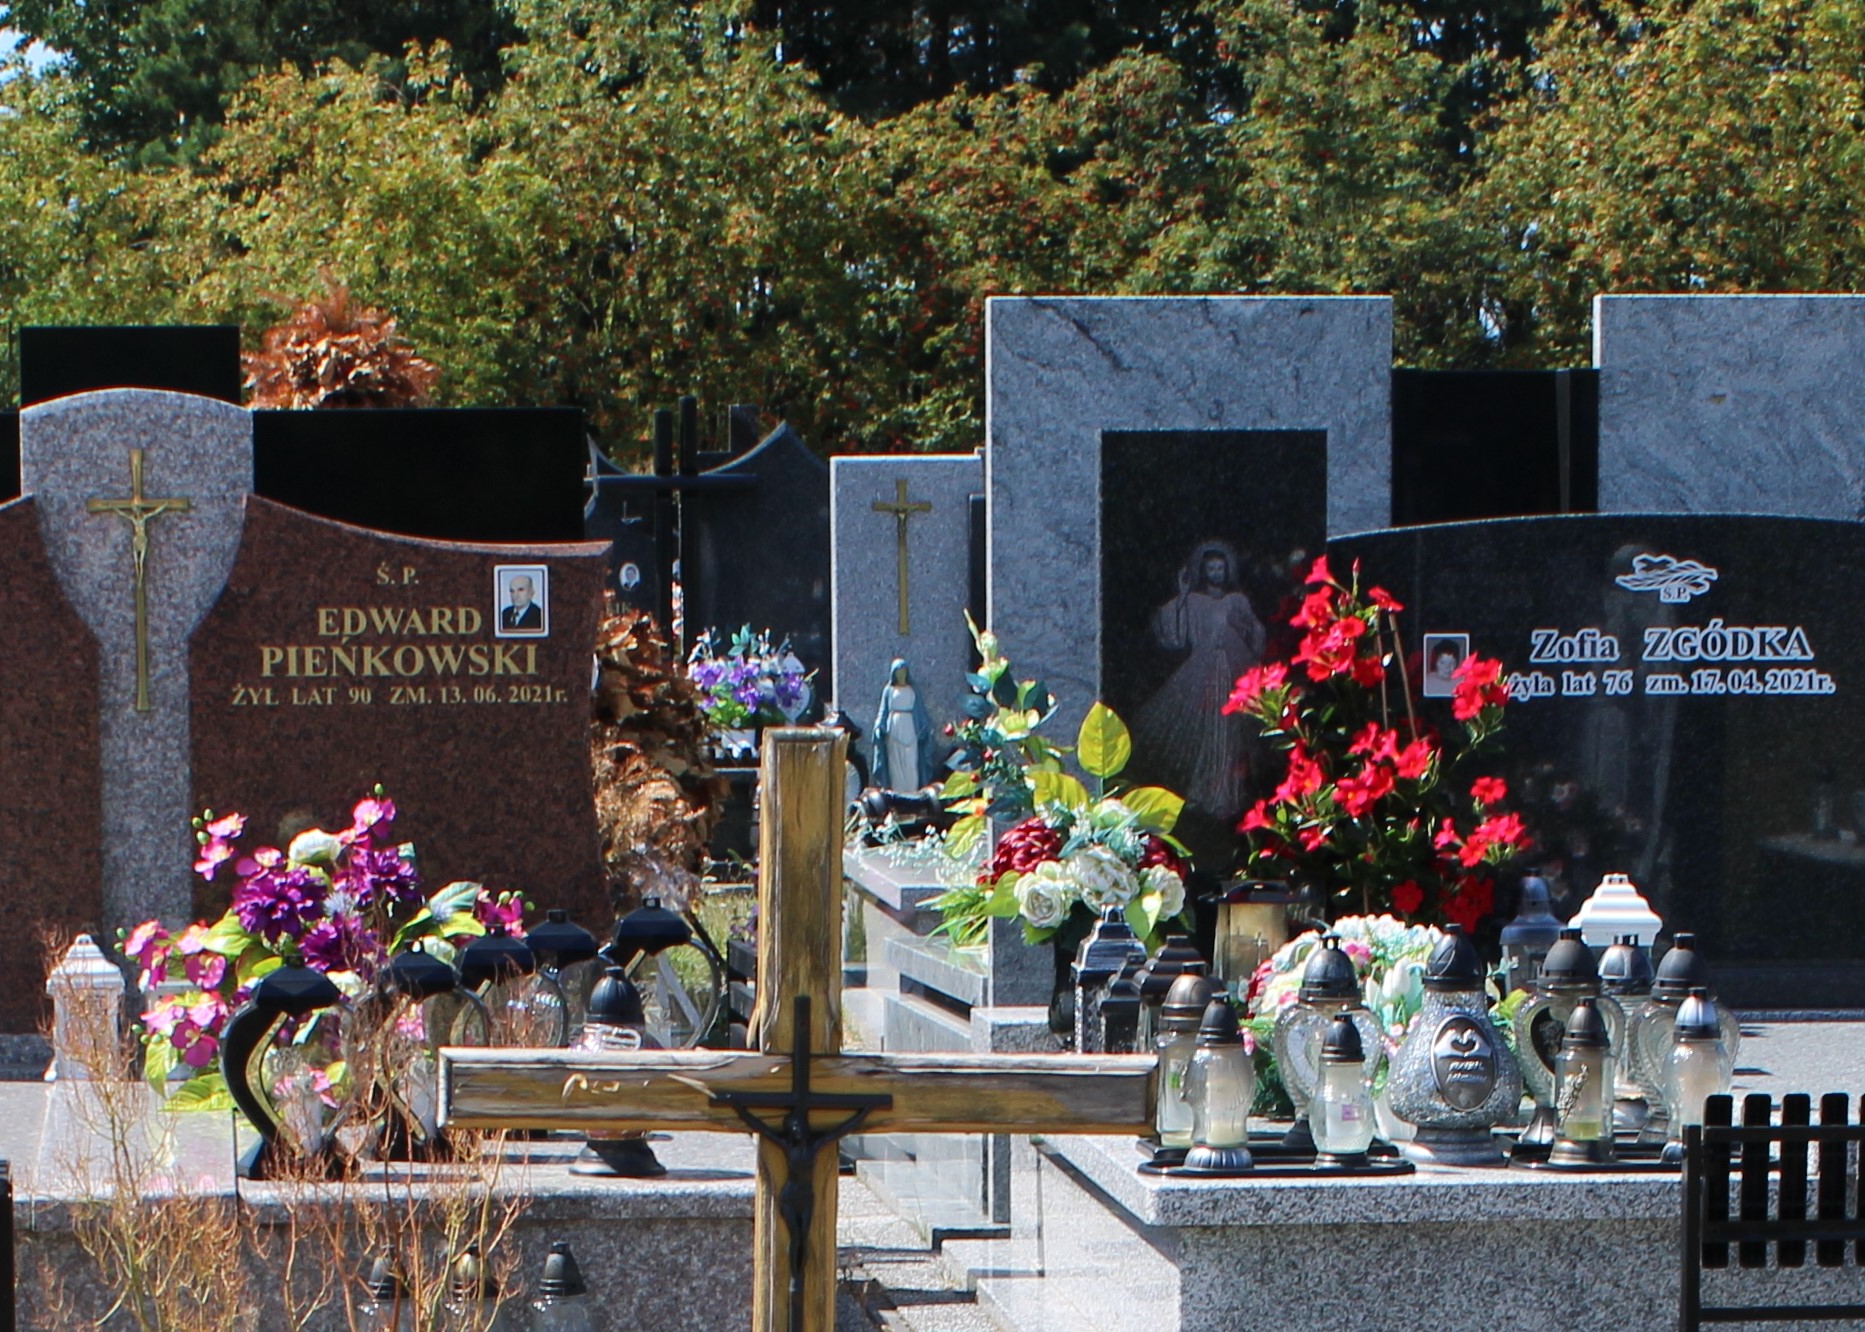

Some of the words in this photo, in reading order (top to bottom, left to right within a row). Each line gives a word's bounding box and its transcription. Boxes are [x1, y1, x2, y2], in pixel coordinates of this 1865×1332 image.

[376, 562, 395, 585] Ś.
[402, 567, 419, 585] P.
[318, 607, 482, 637] EDWARD
[1530, 628, 1620, 662] Zofia
[1643, 619, 1815, 662] ZGÓDKA
[259, 634, 539, 677] PIEŃKOWSKI
[292, 687, 337, 705] LAT
[349, 687, 372, 705] 90
[390, 686, 432, 705] ZM.
[1562, 671, 1597, 696] lat
[1603, 670, 1633, 695] 76
[1646, 673, 1689, 695] zm.
